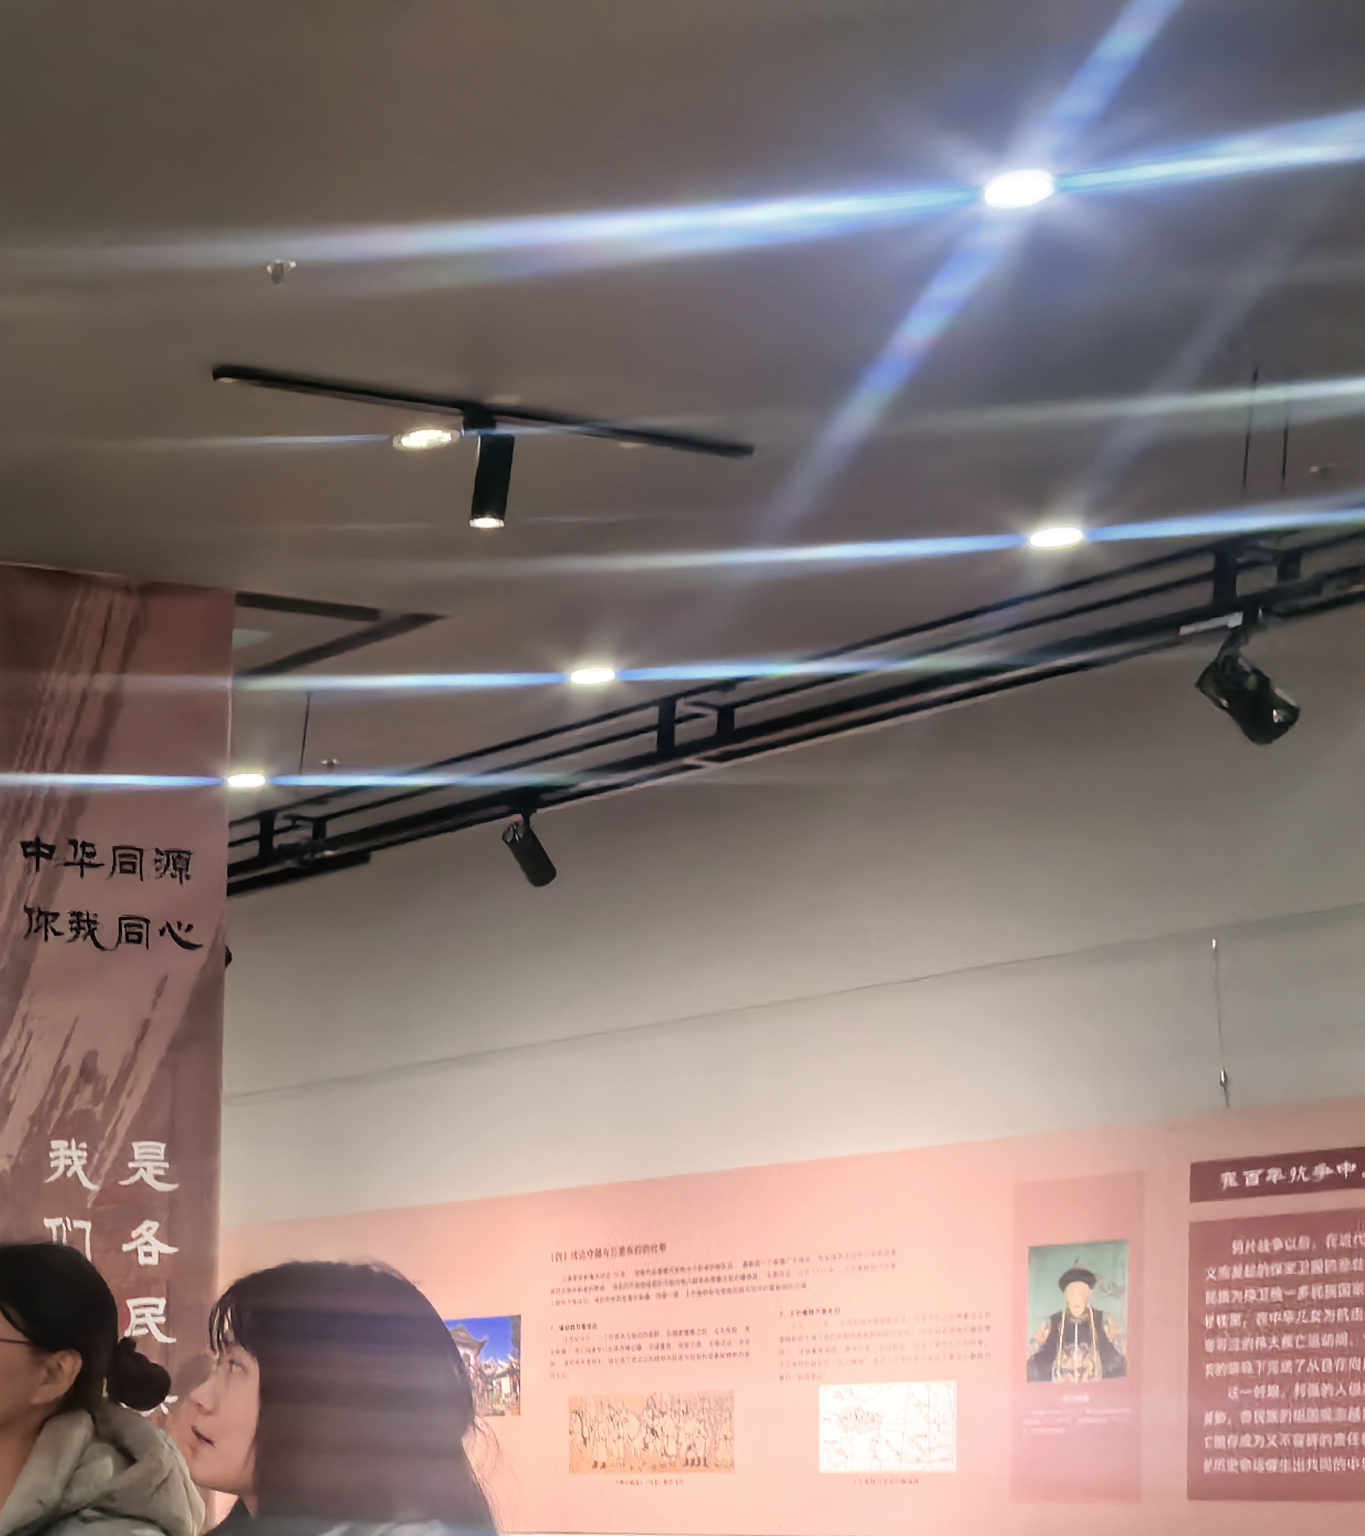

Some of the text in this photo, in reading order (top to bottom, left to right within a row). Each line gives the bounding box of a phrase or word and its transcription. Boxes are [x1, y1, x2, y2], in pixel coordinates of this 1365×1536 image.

[20, 836, 194, 886] 中华同源
[23, 903, 204, 951] 你我同心
[44, 1138, 100, 1262] 我们
[119, 1141, 180, 1416] 是各民
